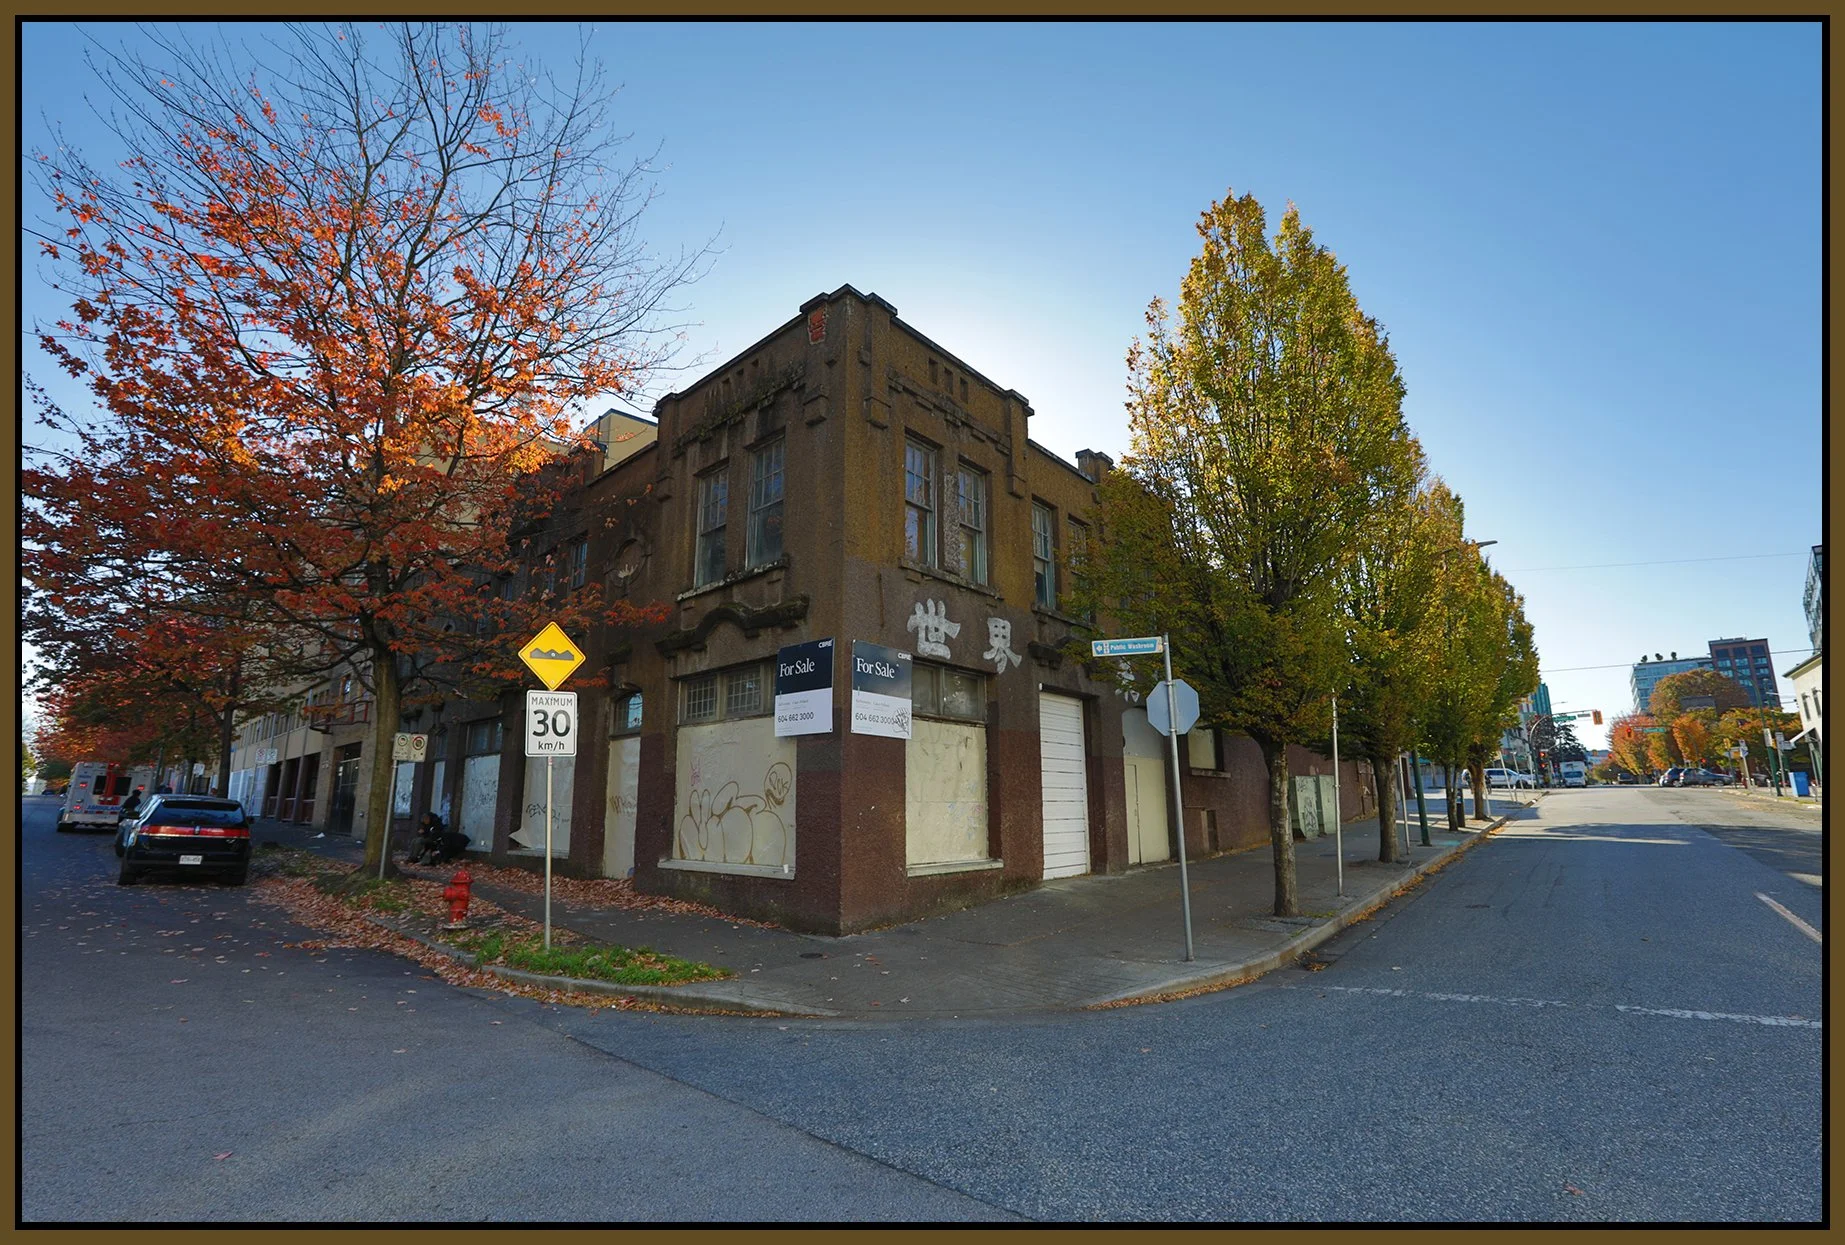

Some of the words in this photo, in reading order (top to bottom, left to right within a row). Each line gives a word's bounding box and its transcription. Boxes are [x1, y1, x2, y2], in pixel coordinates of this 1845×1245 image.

[1127, 642, 1154, 650] Washroom
[779, 662, 795, 678] For
[795, 657, 816, 675] Sale
[856, 657, 875, 675] For
[875, 661, 896, 679] Sale
[531, 696, 573, 707] MAXIMUM
[778, 715, 788, 723] 604
[788, 713, 799, 722] 662
[799, 711, 815, 721] 3000
[855, 712, 868, 721] 604
[868, 714, 880, 723] 662
[532, 709, 571, 738] 30
[537, 741, 565, 752] km/h
